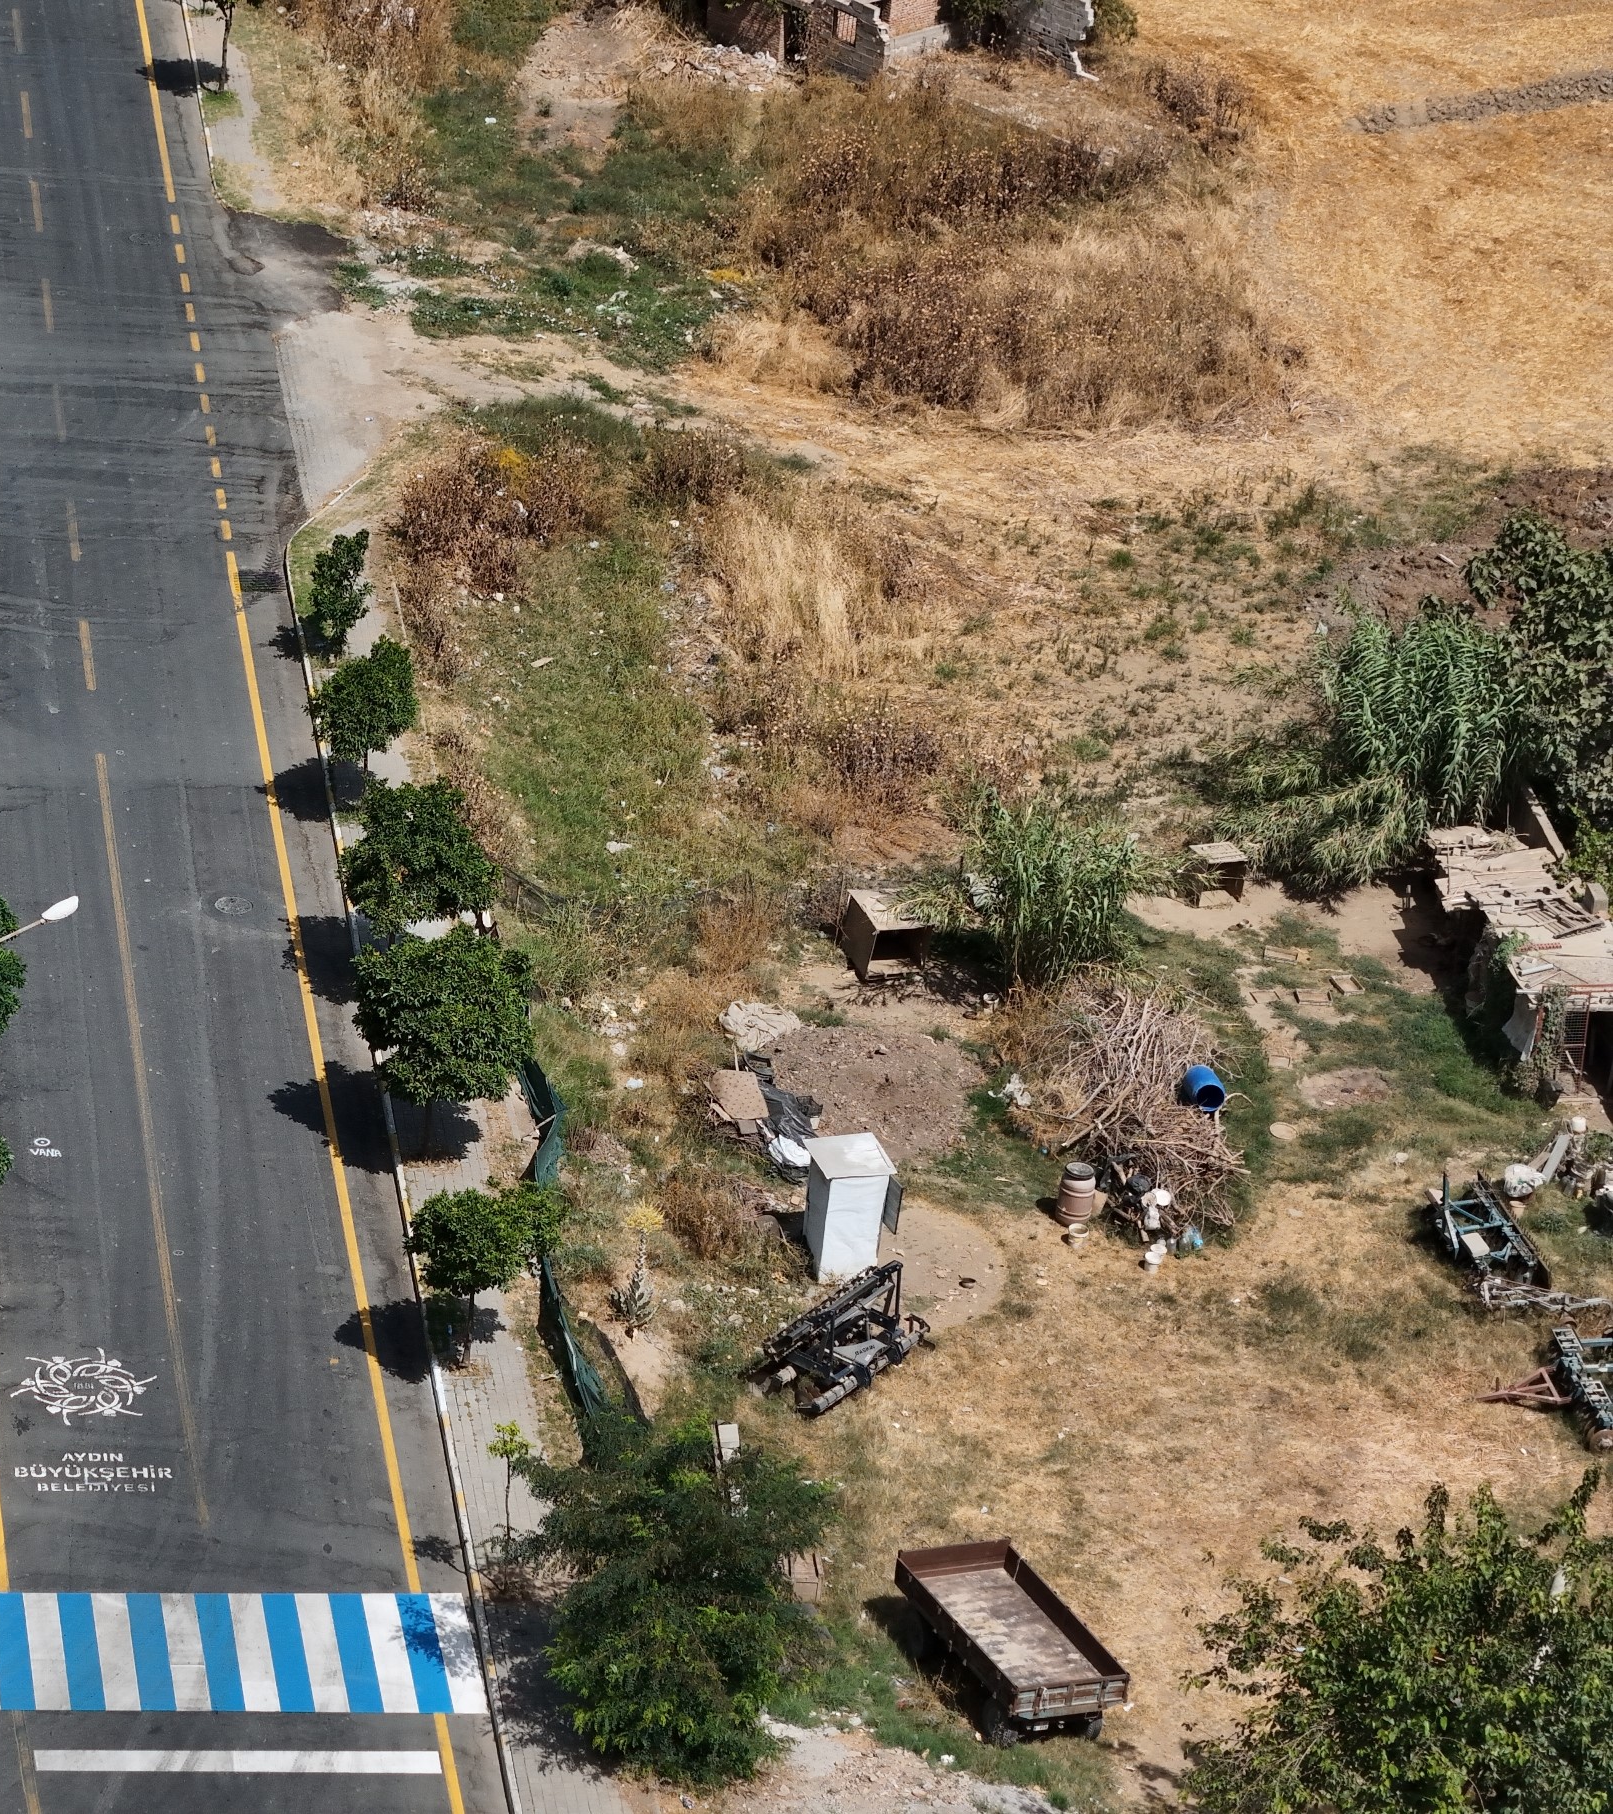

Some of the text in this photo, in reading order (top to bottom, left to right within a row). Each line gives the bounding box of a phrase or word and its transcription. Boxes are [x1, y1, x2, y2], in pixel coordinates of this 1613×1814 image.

[29, 1148, 62, 1157] VANA
[61, 1452, 124, 1462] AYDIN
[14, 1463, 173, 1481] BÜYÜKŞEHİR
[37, 1482, 155, 1492] BELEDİYESİ
